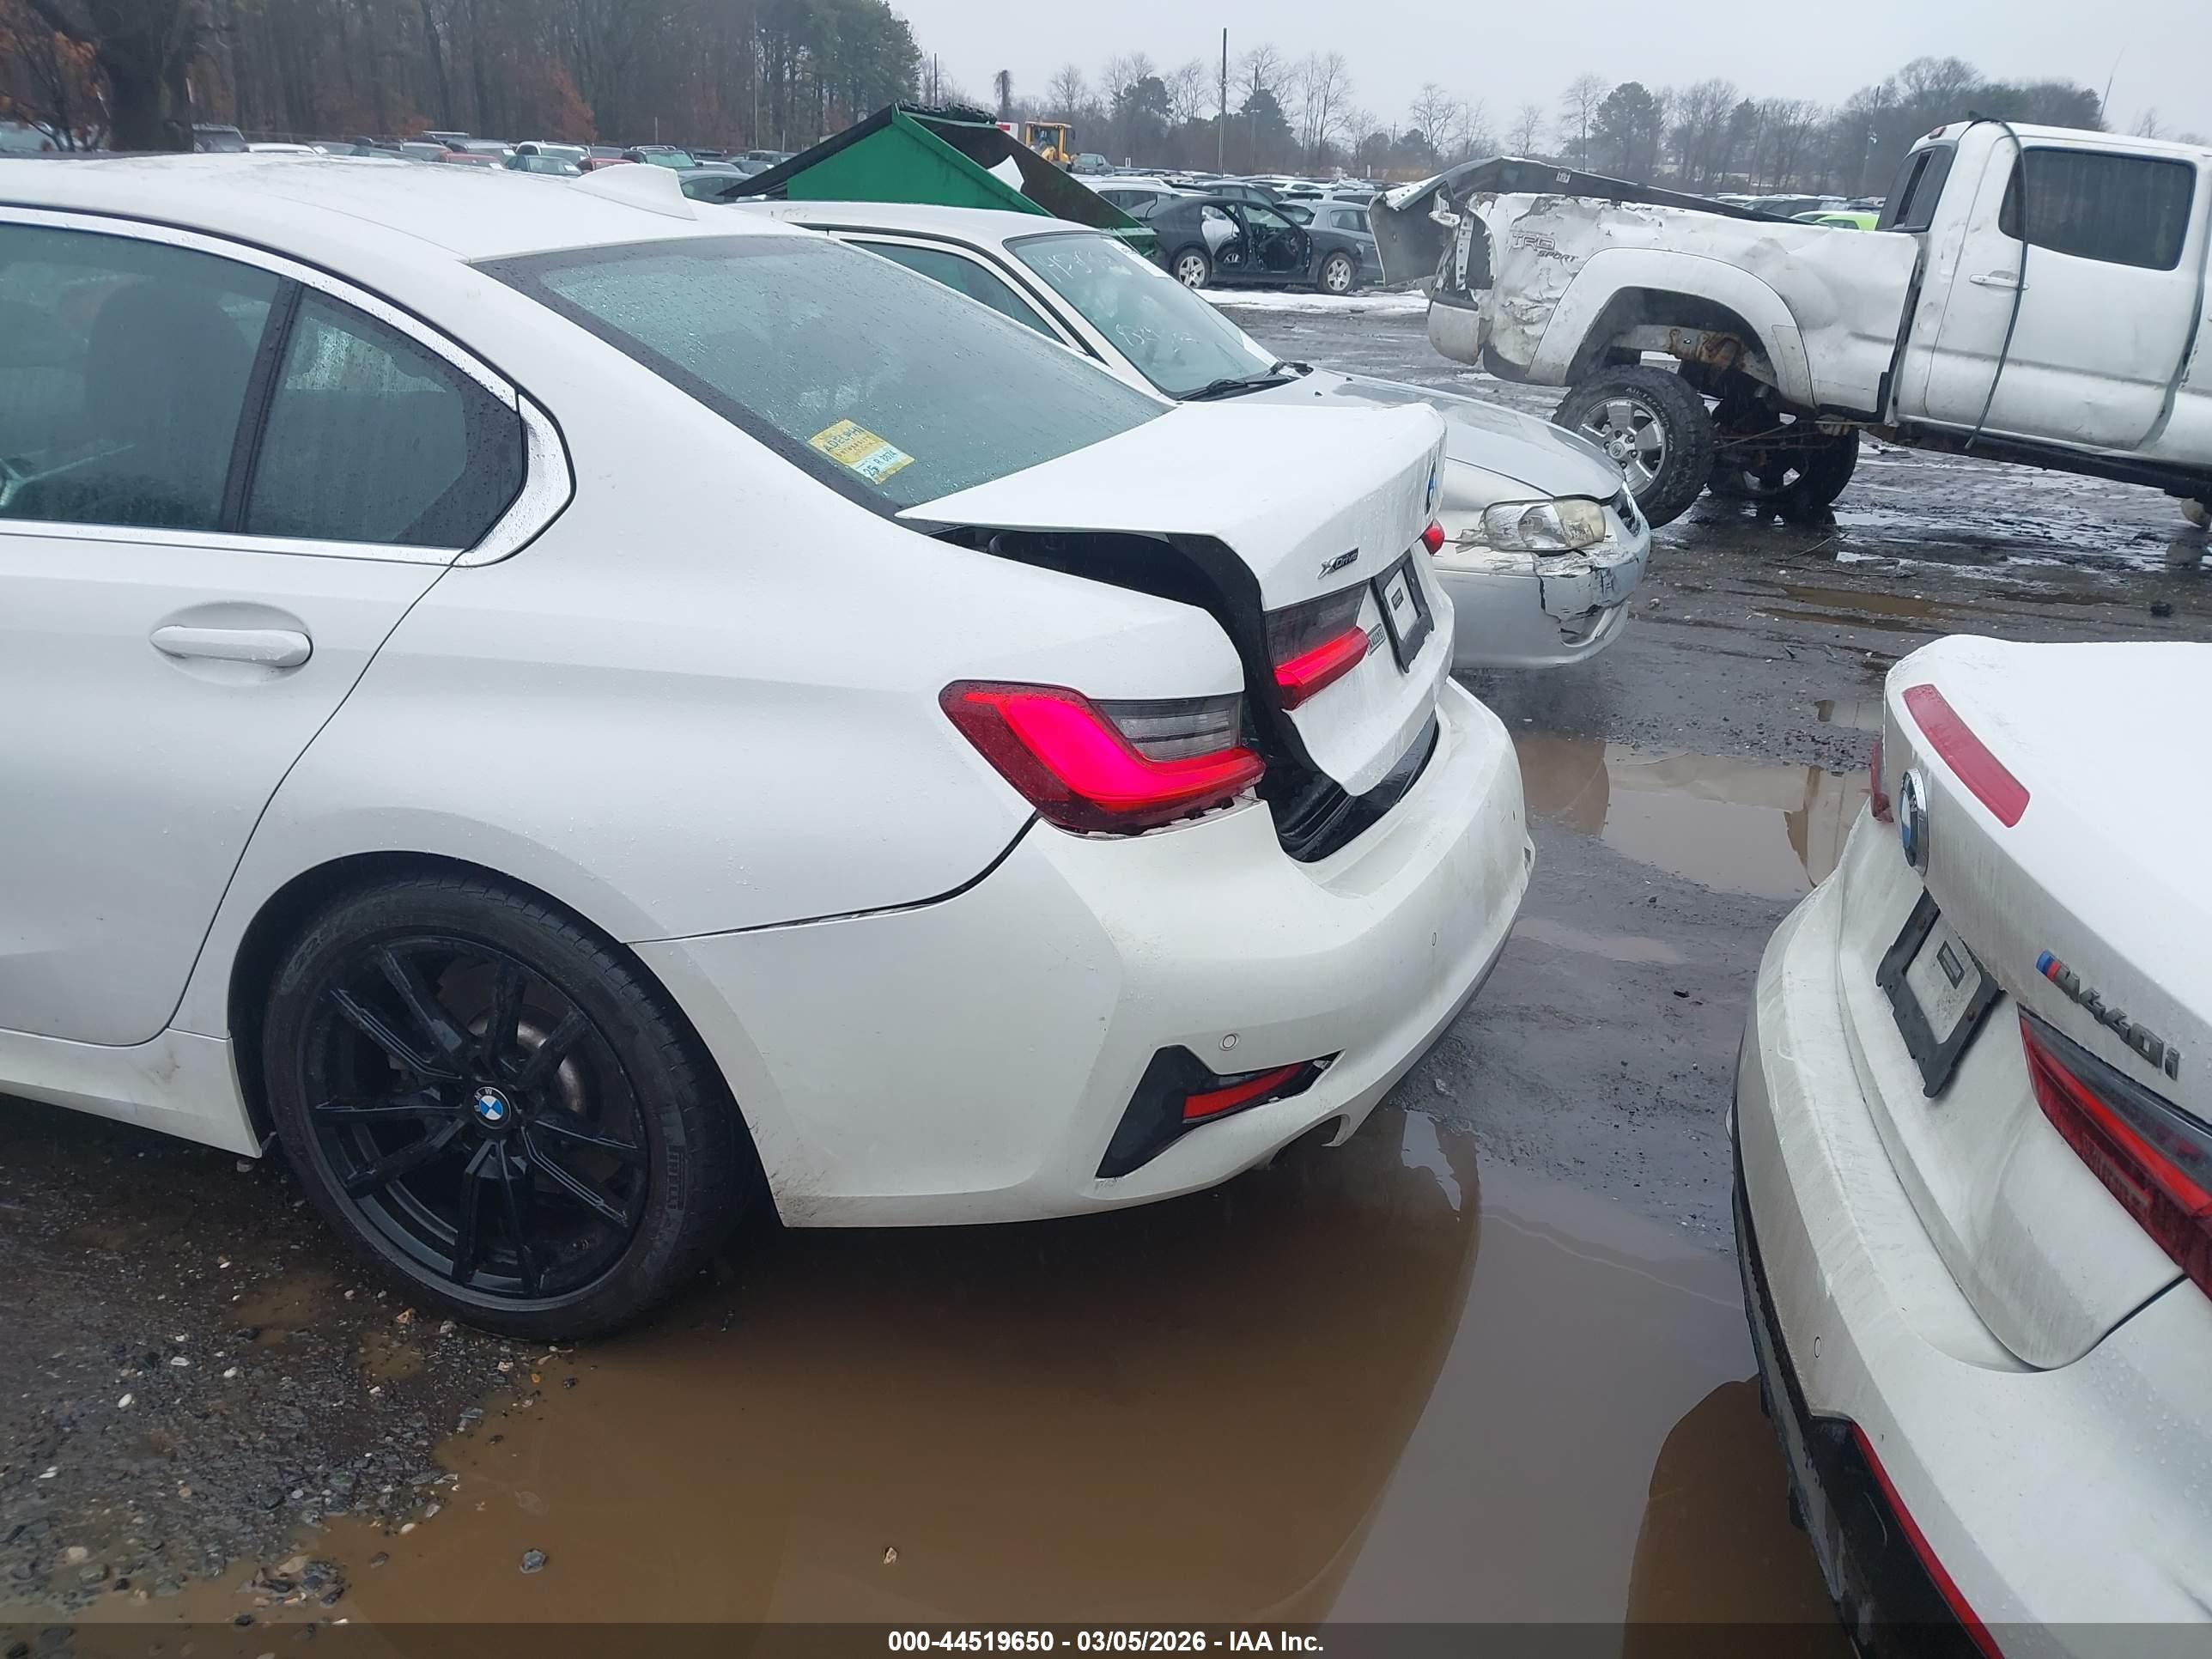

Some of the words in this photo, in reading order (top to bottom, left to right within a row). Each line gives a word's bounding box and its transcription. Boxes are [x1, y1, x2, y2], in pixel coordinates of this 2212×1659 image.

[1512, 233, 1556, 251] TRD
[1537, 250, 1577, 262] SPORT
[823, 426, 865, 452] ADELPHI
[2047, 955, 2181, 1081] M440i
